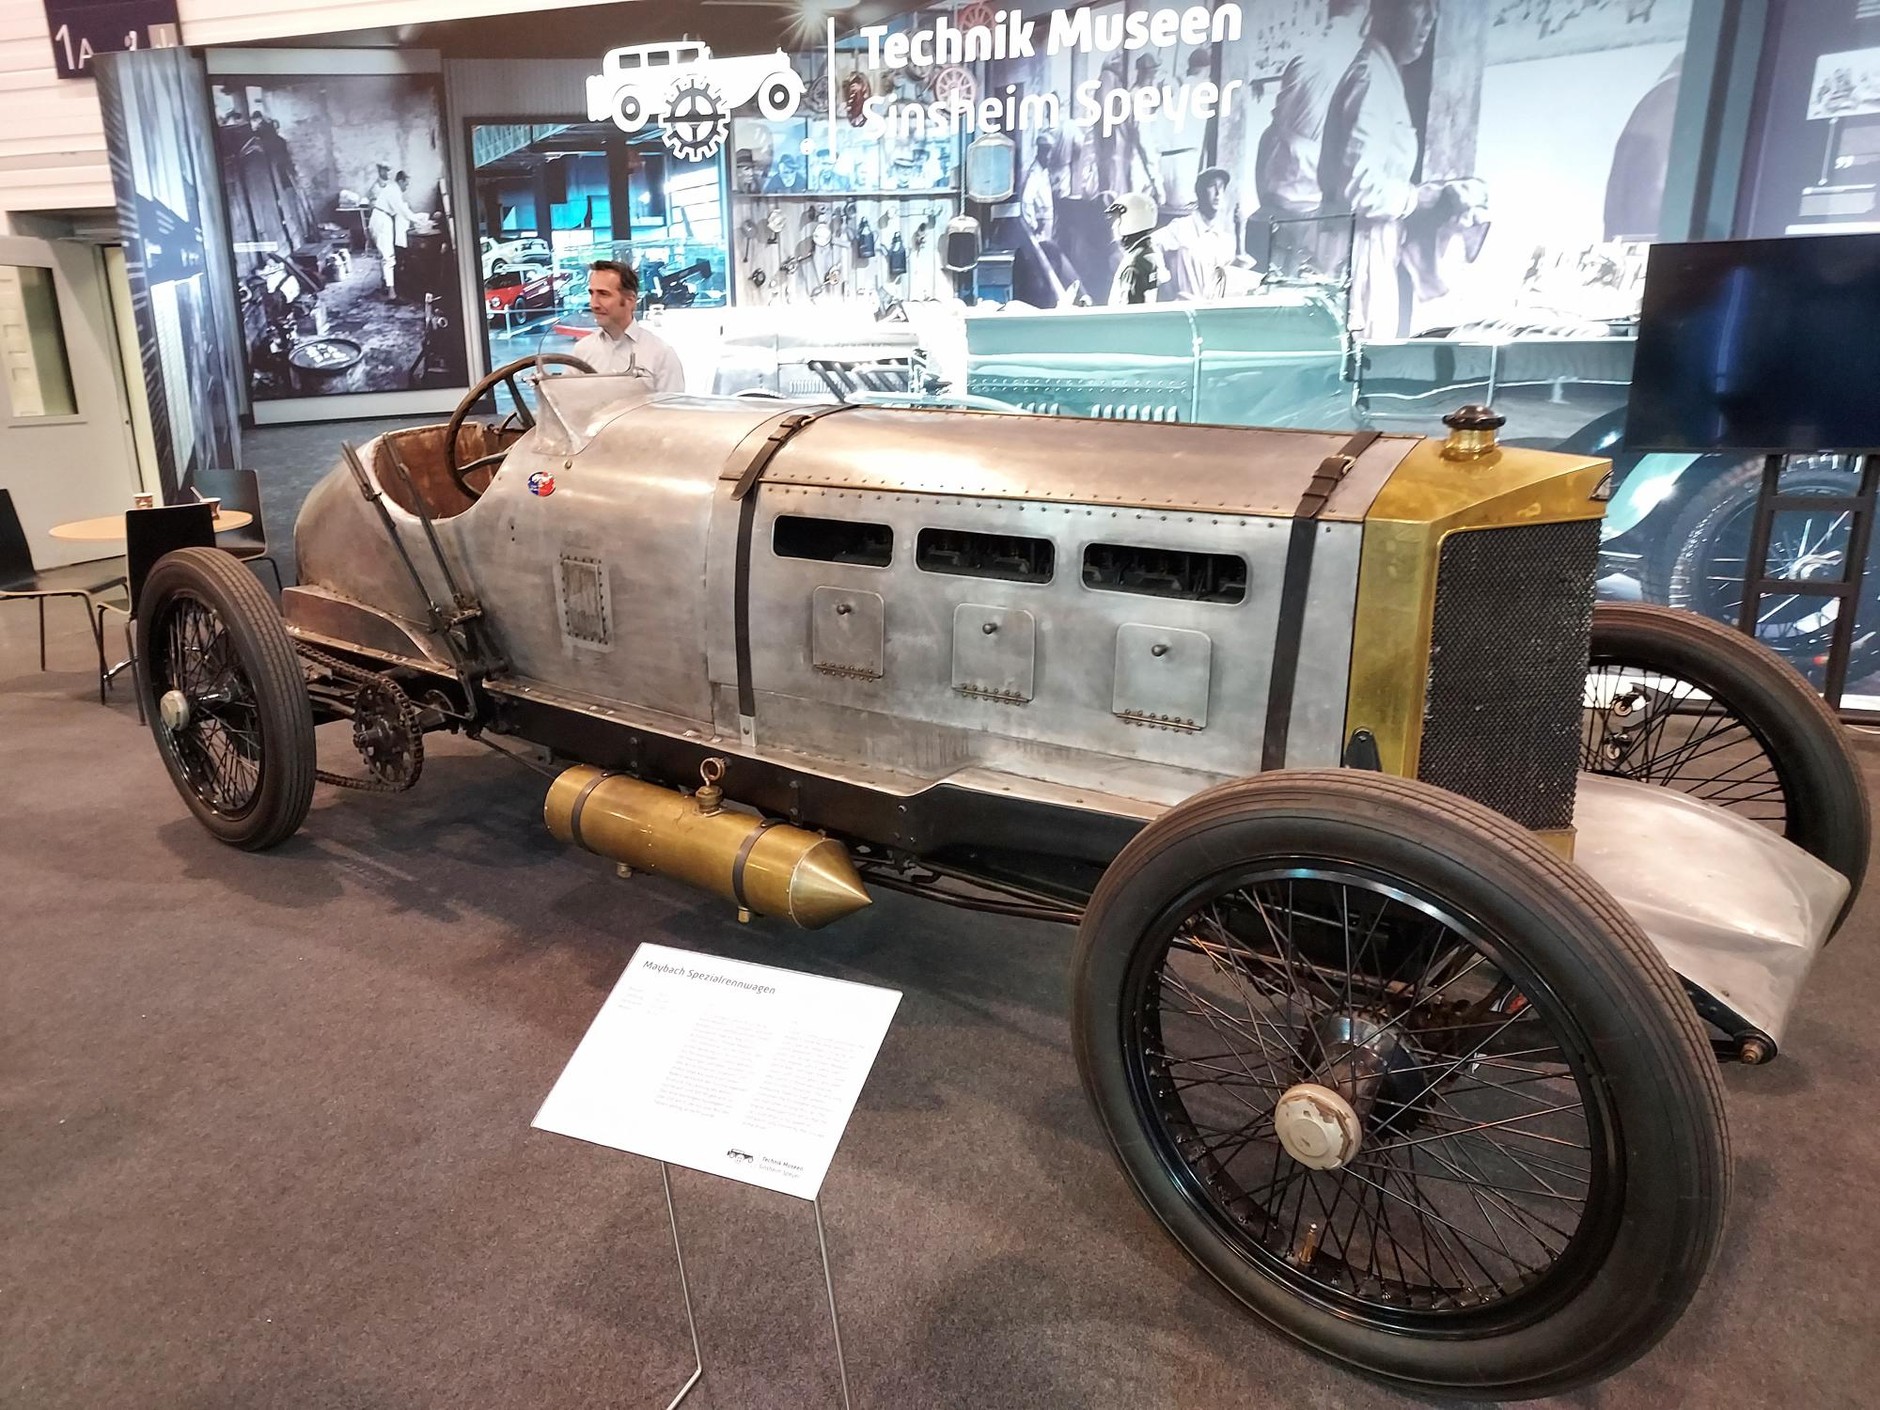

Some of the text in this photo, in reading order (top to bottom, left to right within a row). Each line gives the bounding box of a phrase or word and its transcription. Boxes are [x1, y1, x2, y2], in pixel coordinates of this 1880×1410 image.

[859, 3, 1243, 70] Technik Museen
[861, 79, 1243, 141] Sinsheim Speyer
[643, 960, 776, 995] Maybach Spezialrennwagen
